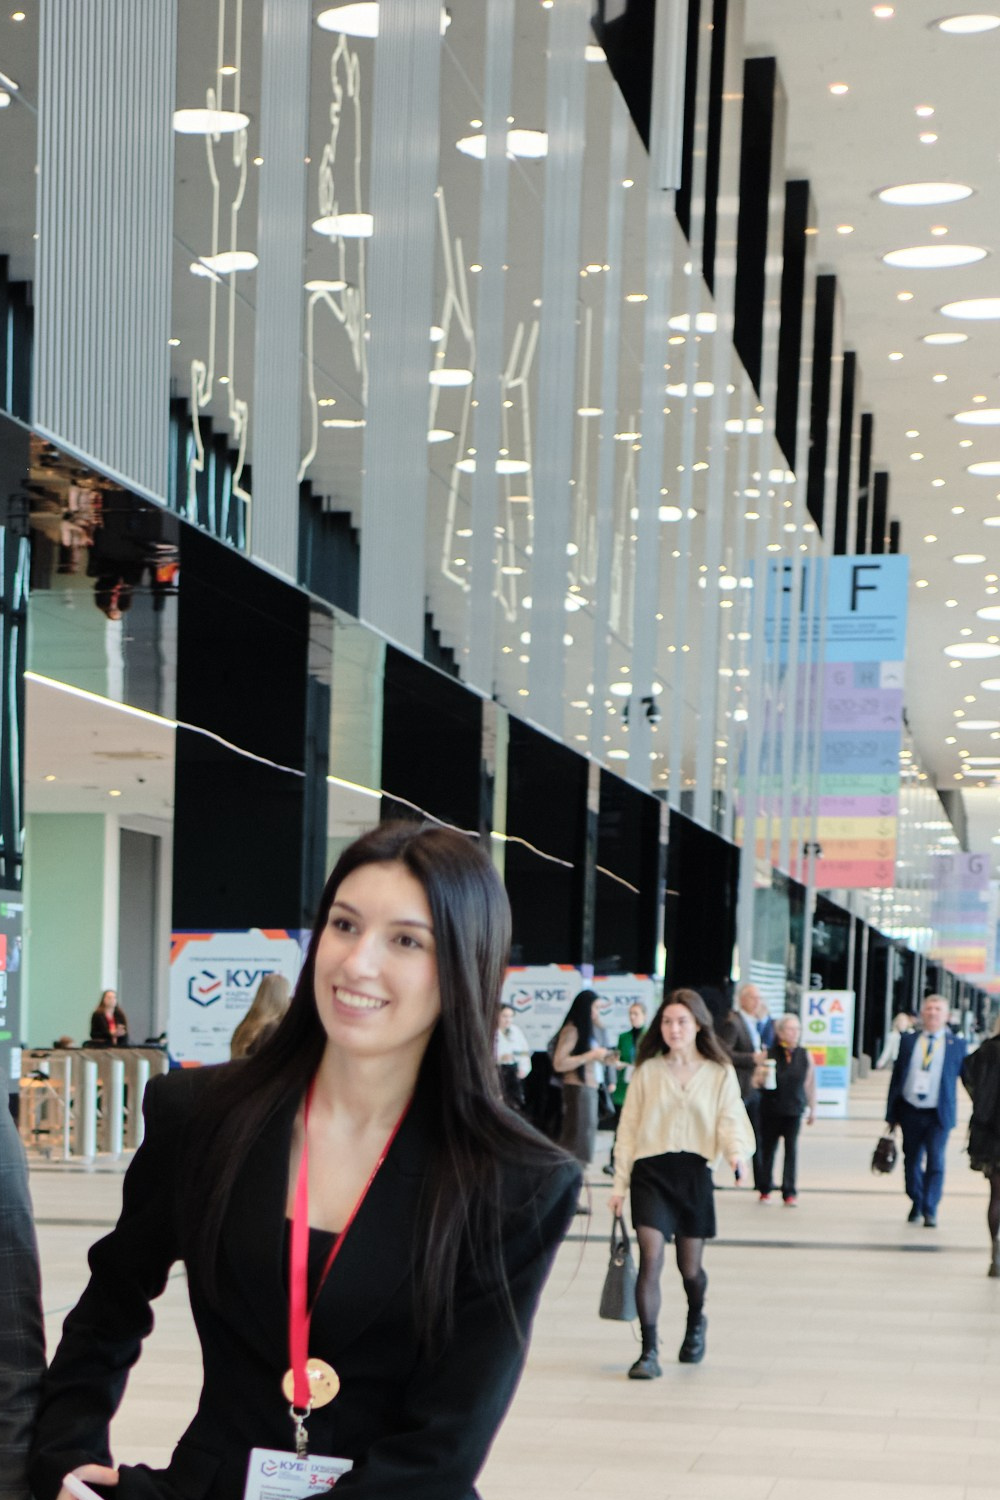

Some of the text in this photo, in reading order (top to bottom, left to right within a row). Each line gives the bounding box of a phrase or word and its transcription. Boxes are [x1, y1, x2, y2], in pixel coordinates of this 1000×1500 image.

[850, 564, 882, 611] F
[968, 854, 983, 874] G
[226, 970, 275, 987] КУ
[280, 1461, 304, 1471] КУБ
